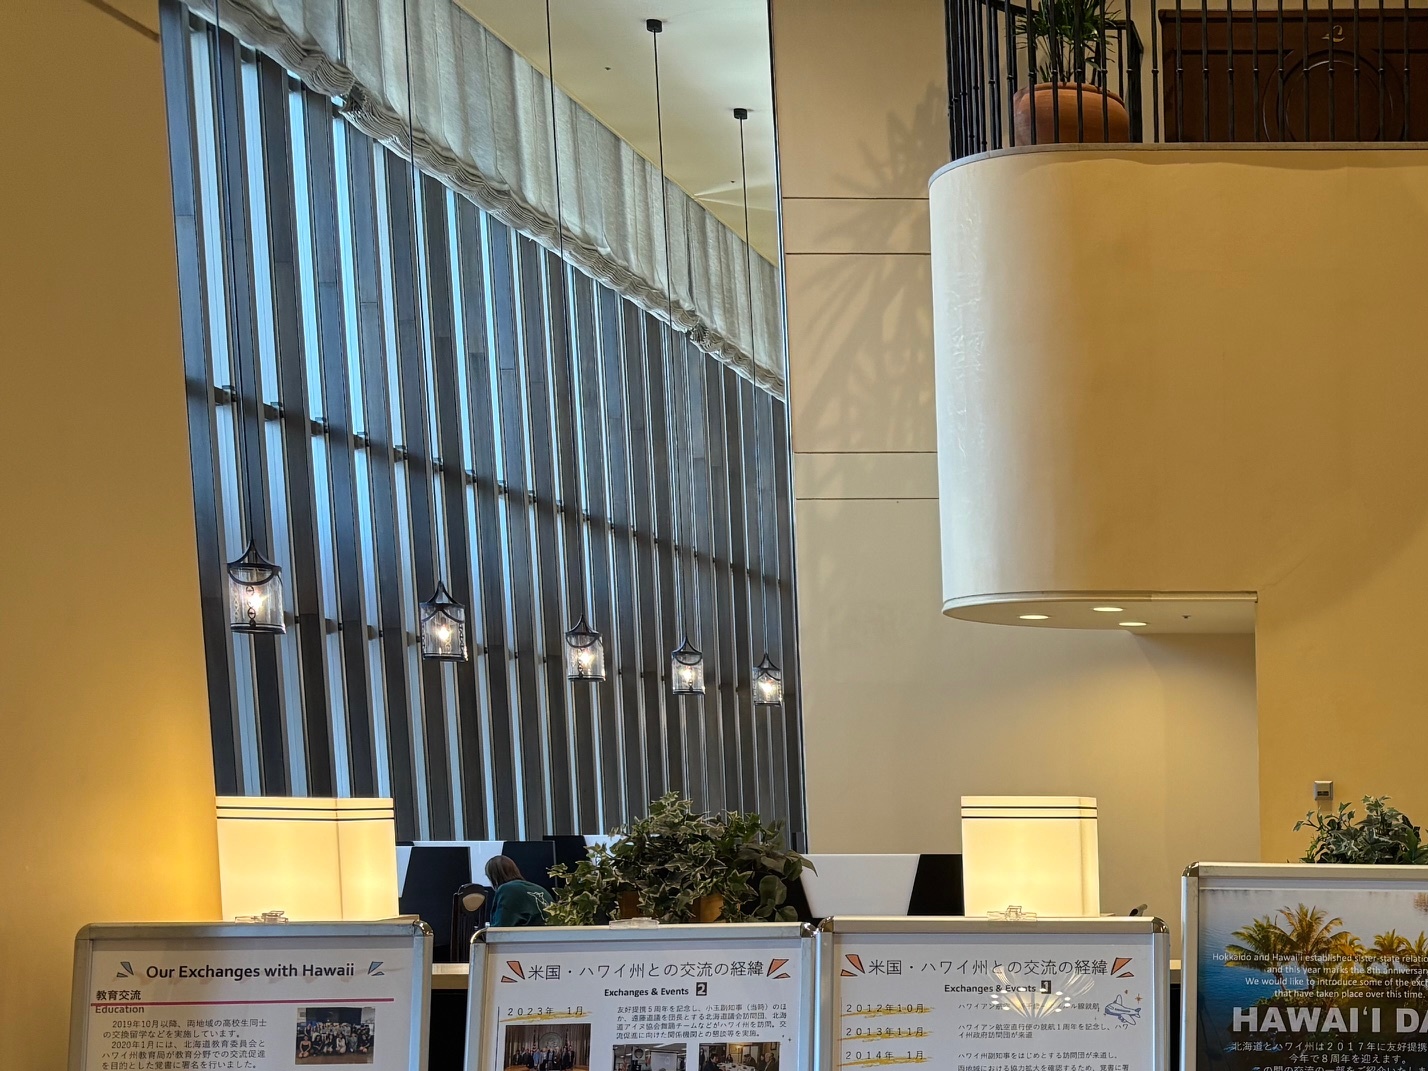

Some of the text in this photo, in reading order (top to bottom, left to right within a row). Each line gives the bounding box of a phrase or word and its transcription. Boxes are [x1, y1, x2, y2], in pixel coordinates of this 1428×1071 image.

[1212, 953, 1252, 962] Hokkaido
[1254, 953, 1270, 962] and
[1304, 953, 1353, 962] established
[1354, 954, 1400, 963] sister-state
[145, 962, 355, 981] Our Exchanges with Hawaii
[528, 961, 764, 981] 米国・ハワイ州との交流の経緯
[868, 958, 1109, 977] 米国・ハワイ州との交流の経緯
[1261, 977, 1287, 986] would
[1289, 977, 1304, 986] like
[1306, 978, 1315, 986] to
[1317, 978, 1357, 986] introduce
[1384, 978, 1393, 986] of
[1395, 978, 1409, 987] the
[95, 989, 142, 1001] 教育交流
[604, 983, 706, 997] Exchanges & Events 2
[944, 984, 994, 995] Exchanges
[1274, 989, 1292, 998] that
[1294, 989, 1313, 998] have
[1316, 989, 1339, 998] taken
[1341, 990, 1363, 999] place
[1386, 990, 1402, 999] this
[1403, 990, 1425, 999] time.
[95, 1004, 145, 1014] Education
[507, 1006, 555, 1017] 2023年
[845, 1002, 925, 1014] 2012年10月
[844, 1026, 924, 1037] 2013年11月
[844, 1050, 895, 1061] 2014年
